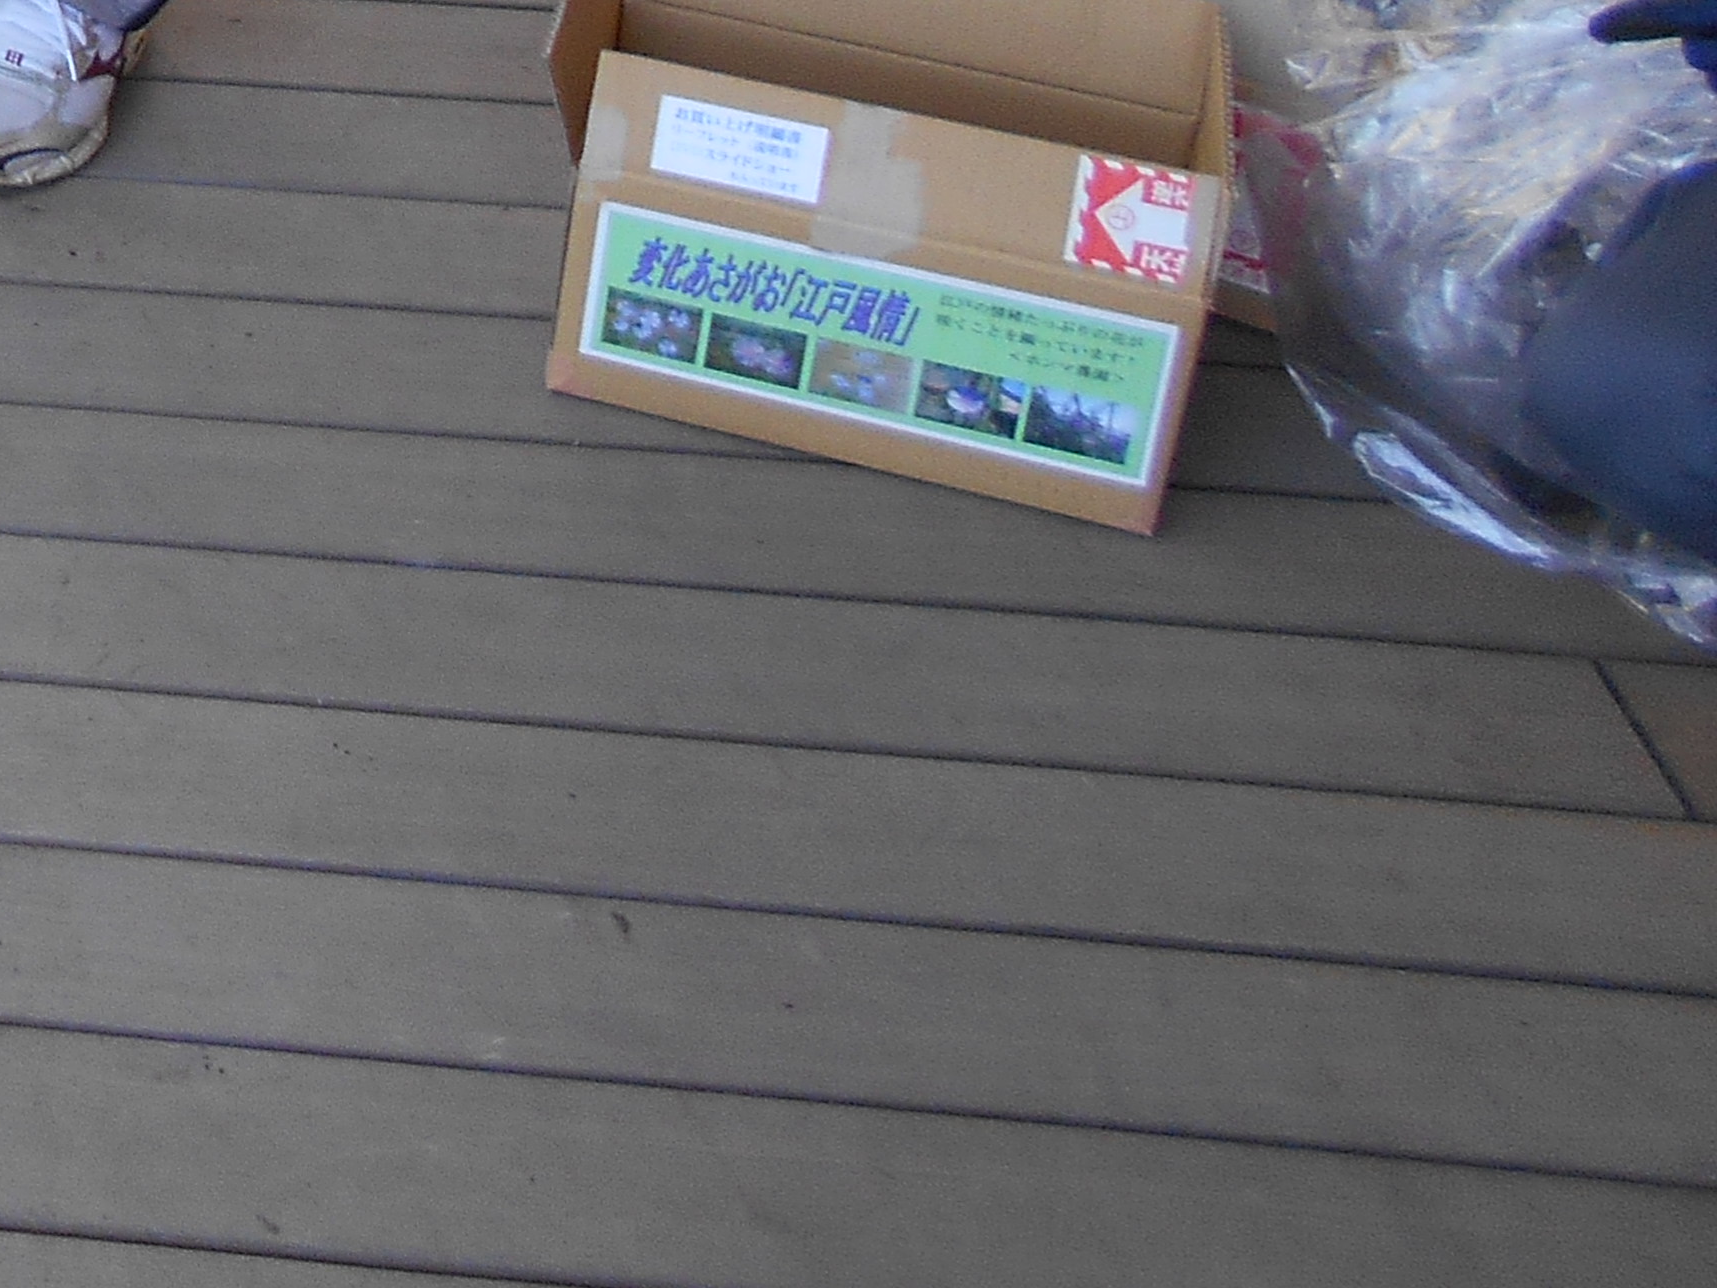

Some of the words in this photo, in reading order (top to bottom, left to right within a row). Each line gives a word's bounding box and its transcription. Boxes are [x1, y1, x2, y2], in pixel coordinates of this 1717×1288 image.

[627, 236, 922, 347] 変化あさがお「江戸風情」
